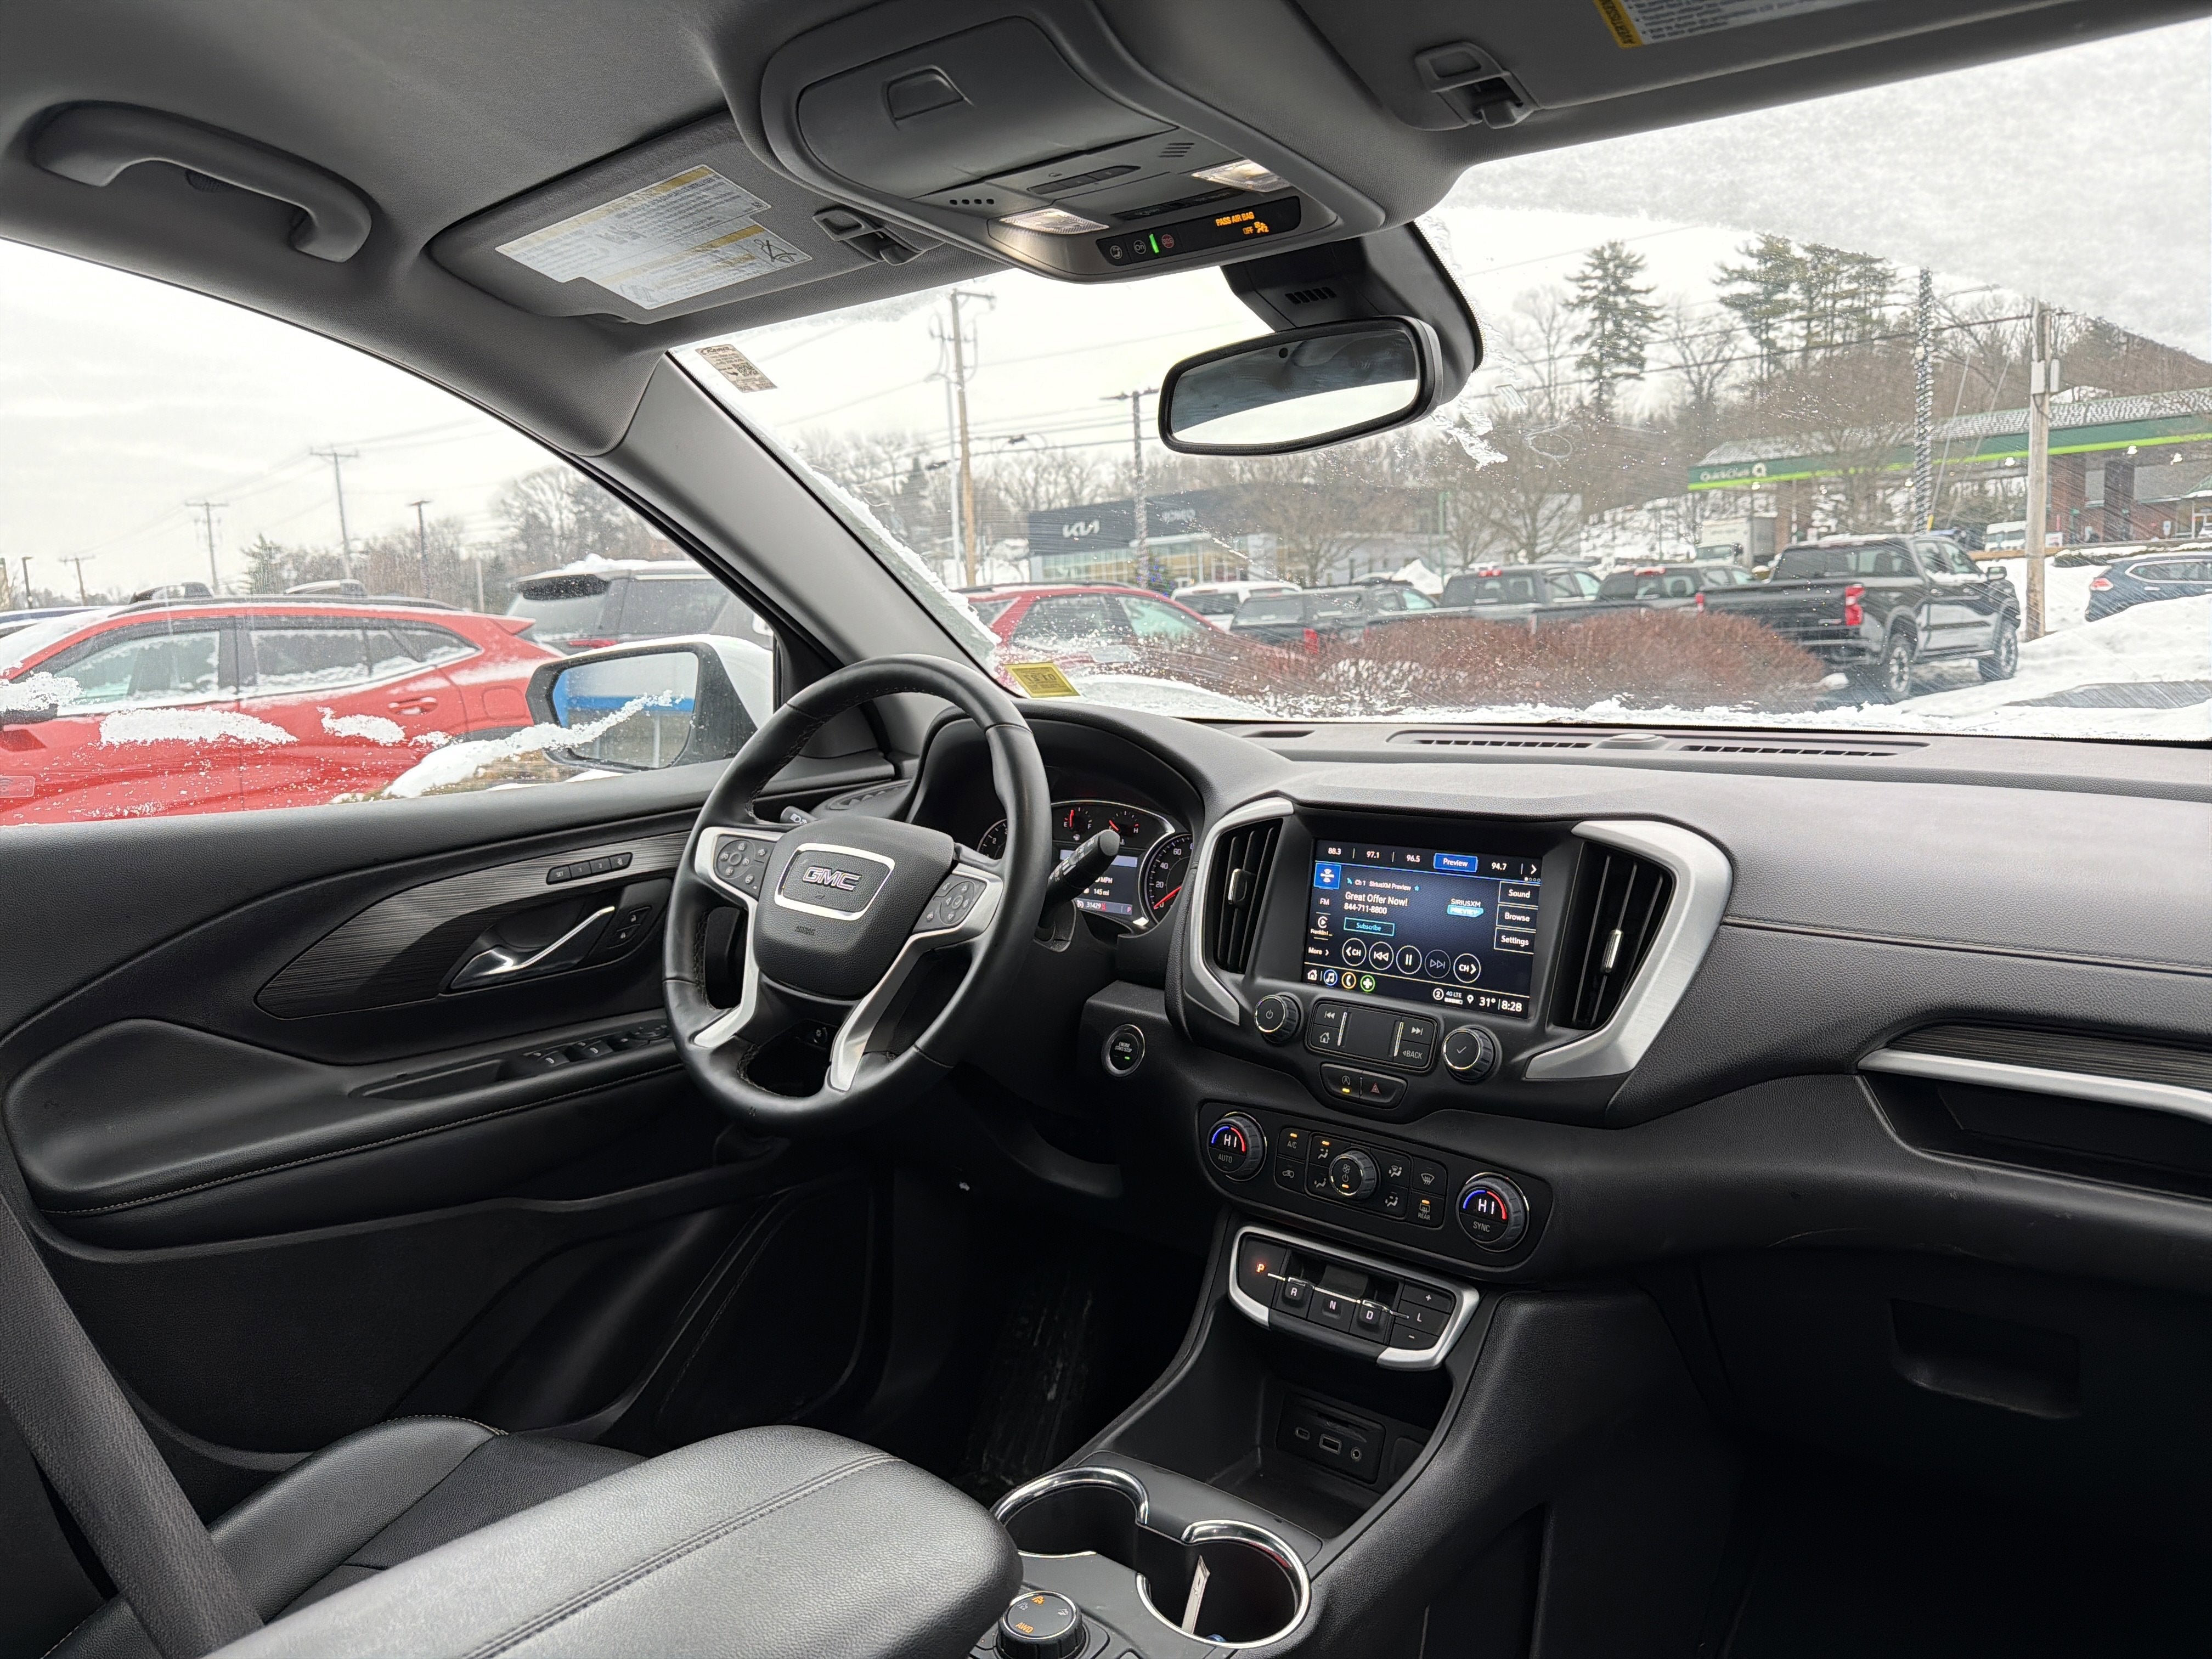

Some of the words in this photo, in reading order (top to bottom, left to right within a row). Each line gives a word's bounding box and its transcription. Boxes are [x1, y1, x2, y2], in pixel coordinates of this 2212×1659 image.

[1215, 216, 1232, 227] PASS
[1232, 214, 1242, 223] AIR
[1242, 211, 1255, 221] BAG
[1243, 226, 1254, 235] OFF
[1135, 242, 1145, 252] On
[1163, 238, 1173, 246] SOS
[1063, 520, 1100, 538] KIA
[1366, 851, 1380, 859] 97.1
[1406, 854, 1420, 862] 96.5
[1443, 858, 1468, 867] Preview
[1491, 861, 1507, 871] 94.7
[802, 865, 862, 891] GMC
[1100, 876, 1113, 884] MPH
[1369, 880, 1391, 890] SiriusXM
[1391, 883, 1412, 891] Preview
[1345, 891, 1366, 902] Great
[1367, 893, 1387, 904] Offer
[1387, 896, 1408, 906] Now!
[1508, 889, 1530, 899] Sound
[1086, 901, 1102, 910] 31429
[1319, 898, 1330, 906] FM
[1451, 898, 1481, 907] SIRIUSXM
[1344, 902, 1387, 915] 844-711-8800
[1504, 912, 1530, 922] Browse
[1356, 922, 1381, 932] Subscribe
[1500, 935, 1530, 947] Settings
[1308, 946, 1323, 955] More
[1352, 949, 1362, 957] CH
[1458, 964, 1470, 972] CH
[1479, 996, 1496, 1007] 31°
[1501, 1000, 1523, 1013] 8:28
[1406, 1050, 1424, 1060] BACK
[1223, 1133, 1237, 1148] HI
[1286, 1140, 1297, 1150] A/C
[1217, 1153, 1233, 1164] AUTO
[1478, 1198, 1495, 1215] HI
[1418, 1212, 1431, 1221] REAR
[1472, 1221, 1491, 1233] SYNC
[1256, 1263, 1265, 1273] P
[1290, 1288, 1298, 1297] R
[1329, 1301, 1336, 1311] N
[1366, 1311, 1373, 1320] D
[1417, 1313, 1423, 1322] L
[1015, 1621, 1034, 1634] AWD
